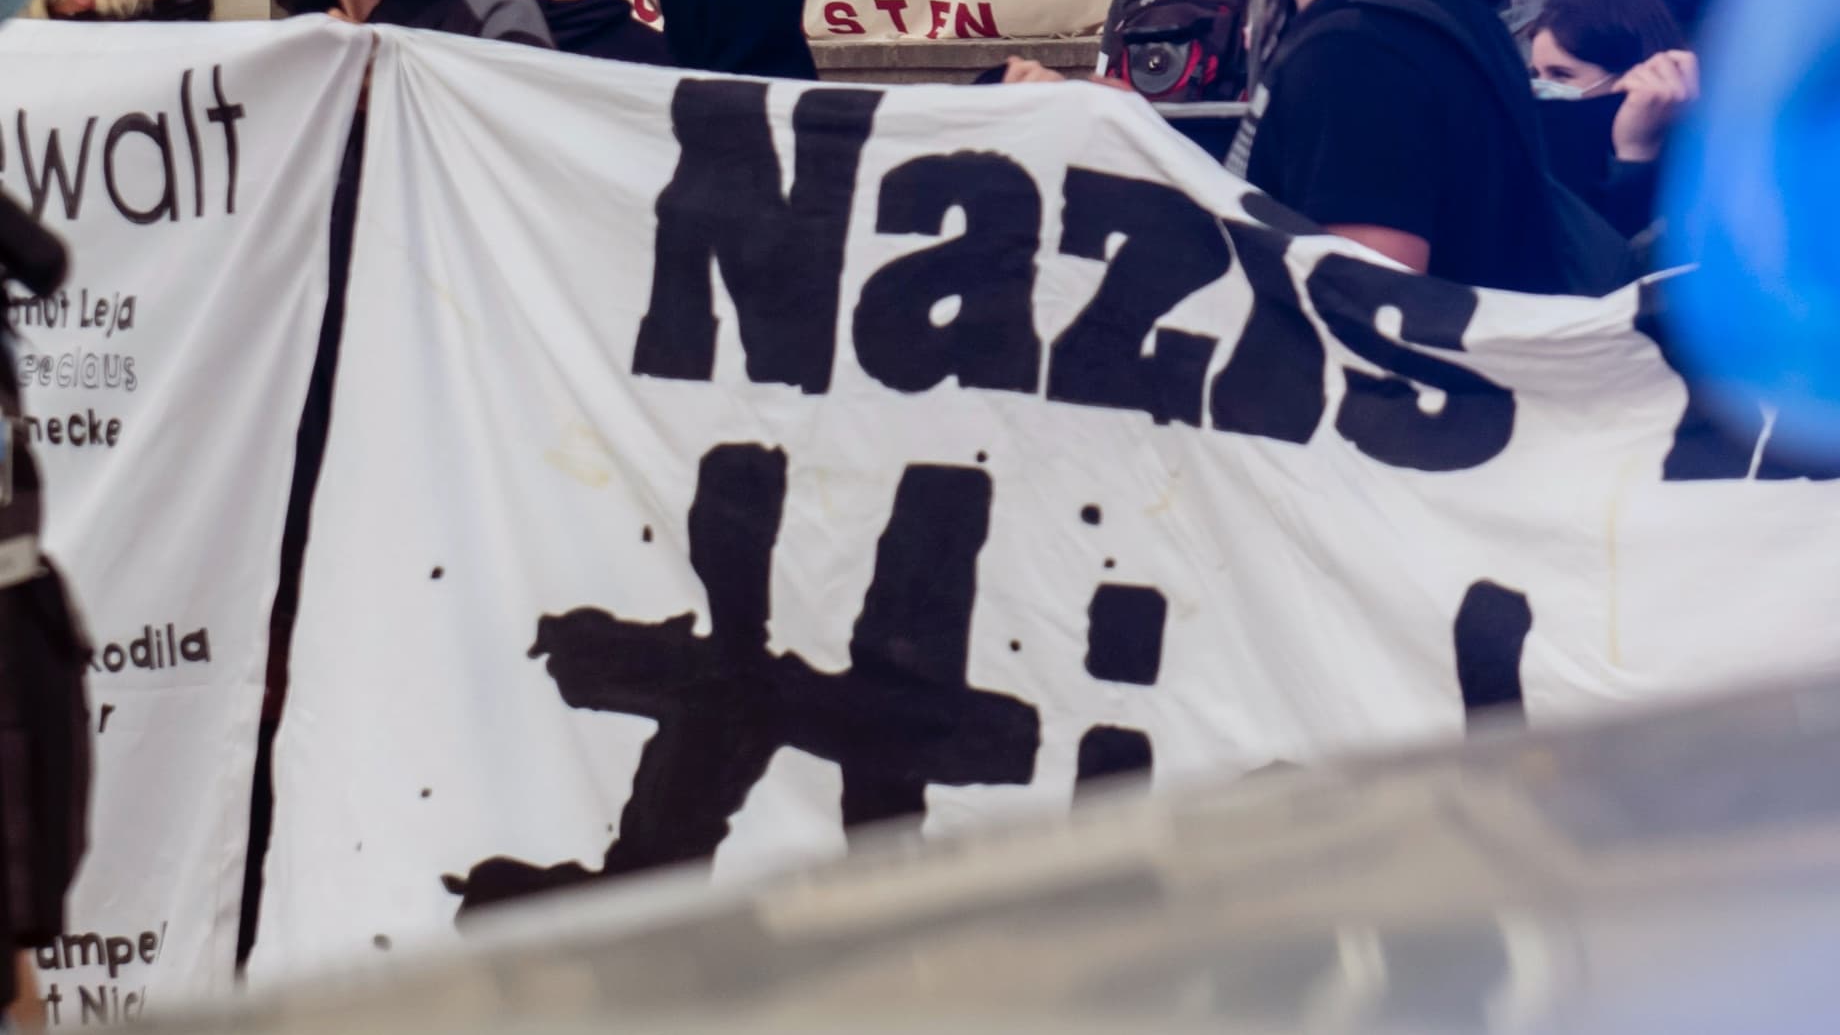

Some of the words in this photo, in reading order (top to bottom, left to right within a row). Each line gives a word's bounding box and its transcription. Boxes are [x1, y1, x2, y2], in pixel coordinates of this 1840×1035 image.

[0, 63, 247, 226] walt
[79, 287, 138, 339] Leja
[631, 77, 1517, 472] Nazis
[24, 407, 122, 448] necke
